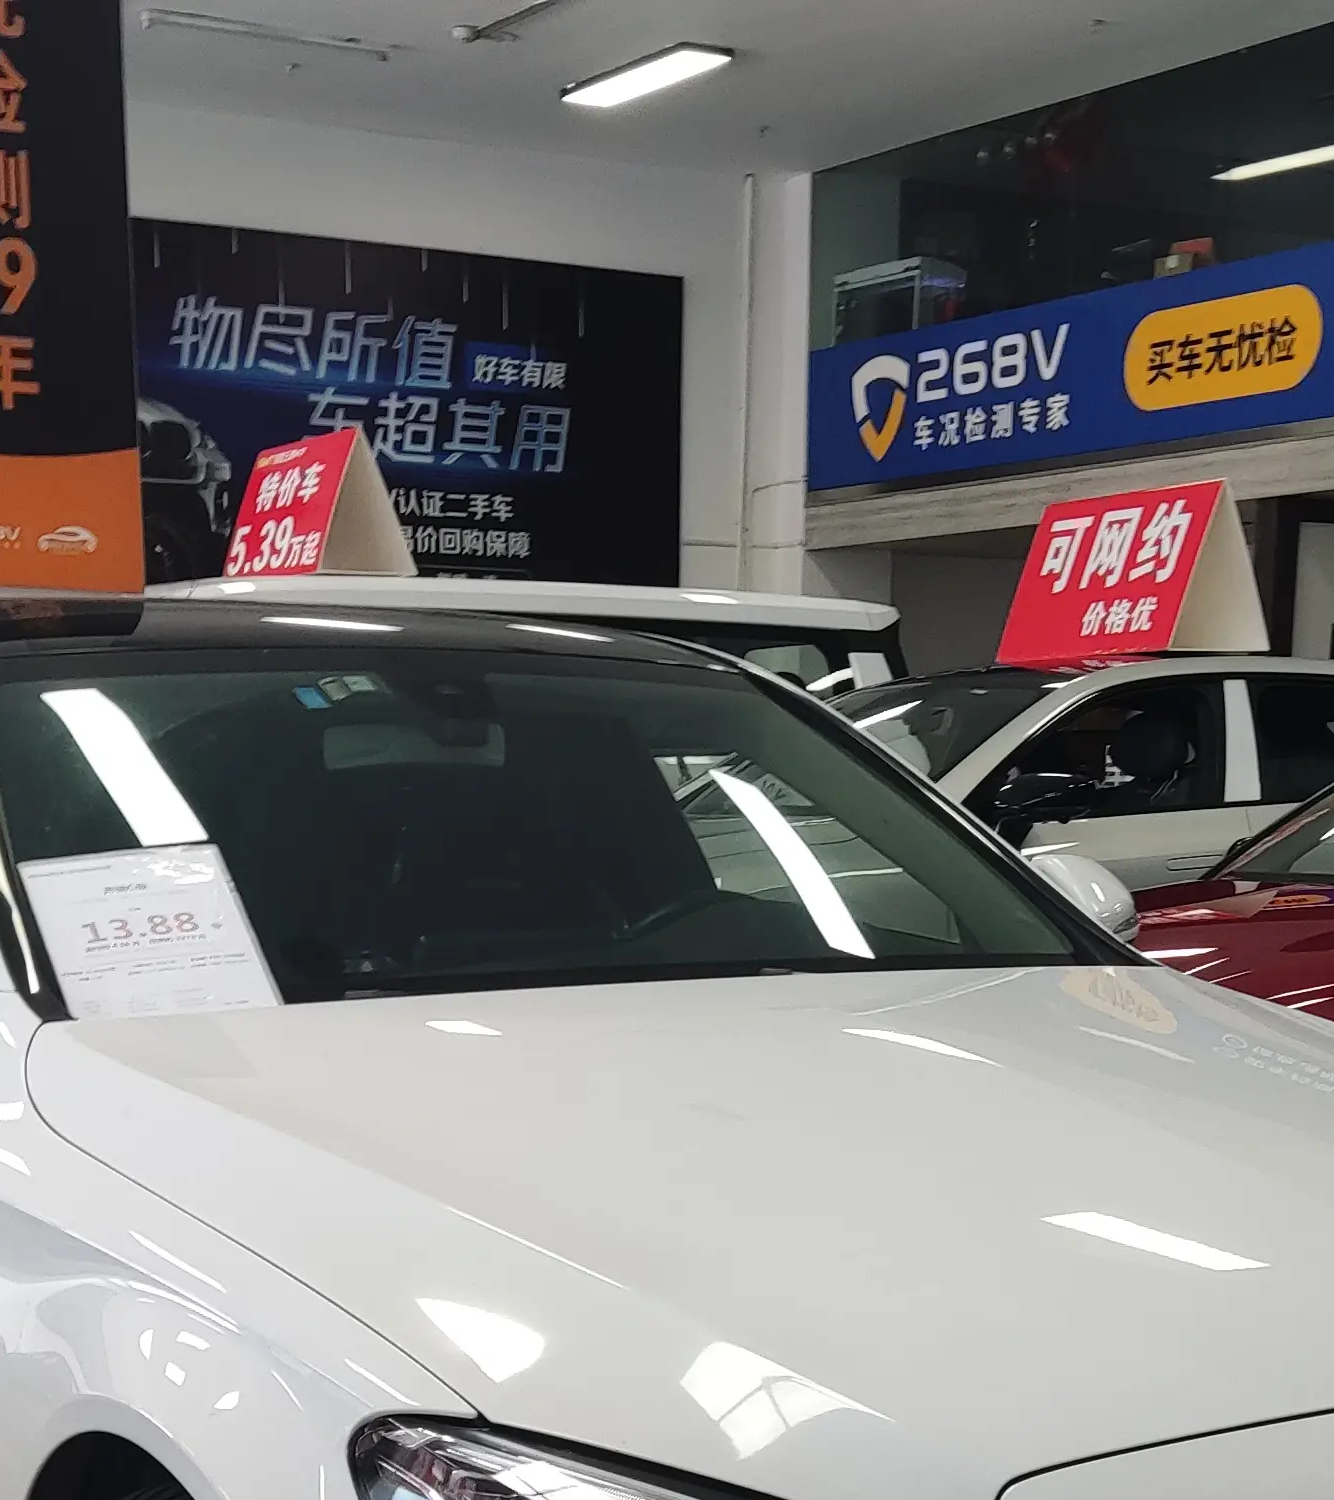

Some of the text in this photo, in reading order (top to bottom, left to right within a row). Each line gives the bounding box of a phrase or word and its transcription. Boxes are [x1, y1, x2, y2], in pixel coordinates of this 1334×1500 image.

[169, 294, 458, 389] 物尽所值
[472, 353, 568, 390] 好车有限
[916, 323, 1071, 404] 268V
[1146, 315, 1298, 386] 买车无忧检
[303, 386, 571, 473] 车超其用
[913, 391, 1071, 451] 车况检测专家
[255, 461, 327, 514] 特价车
[1040, 499, 1194, 594] 可网约
[1080, 596, 1158, 637] 价格优
[81, 912, 201, 944] 13.88
